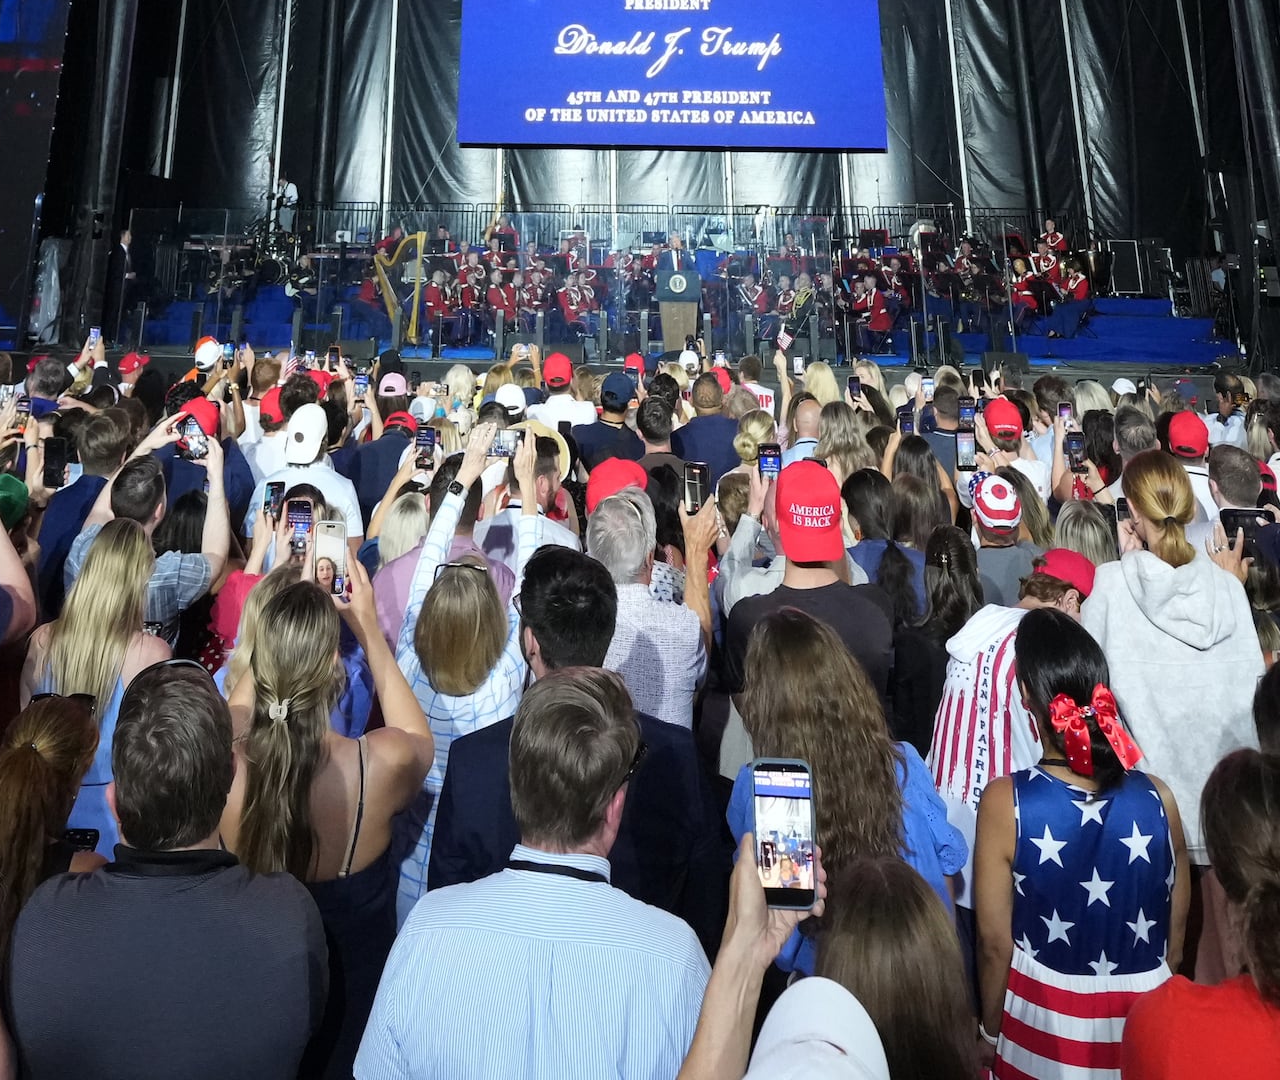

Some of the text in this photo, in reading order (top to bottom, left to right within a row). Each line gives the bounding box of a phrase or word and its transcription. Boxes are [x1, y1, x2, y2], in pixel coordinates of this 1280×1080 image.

[554, 24, 782, 78] Donald J. Trump
[567, 90, 771, 106] 45TH AND 47TH PRESIDENT
[525, 108, 815, 124] OF THE UNITED STATES OF AMERICA
[789, 503, 835, 517] AMERICA
[793, 514, 831, 528] IS BACK
[980, 642, 996, 700] RICAN
